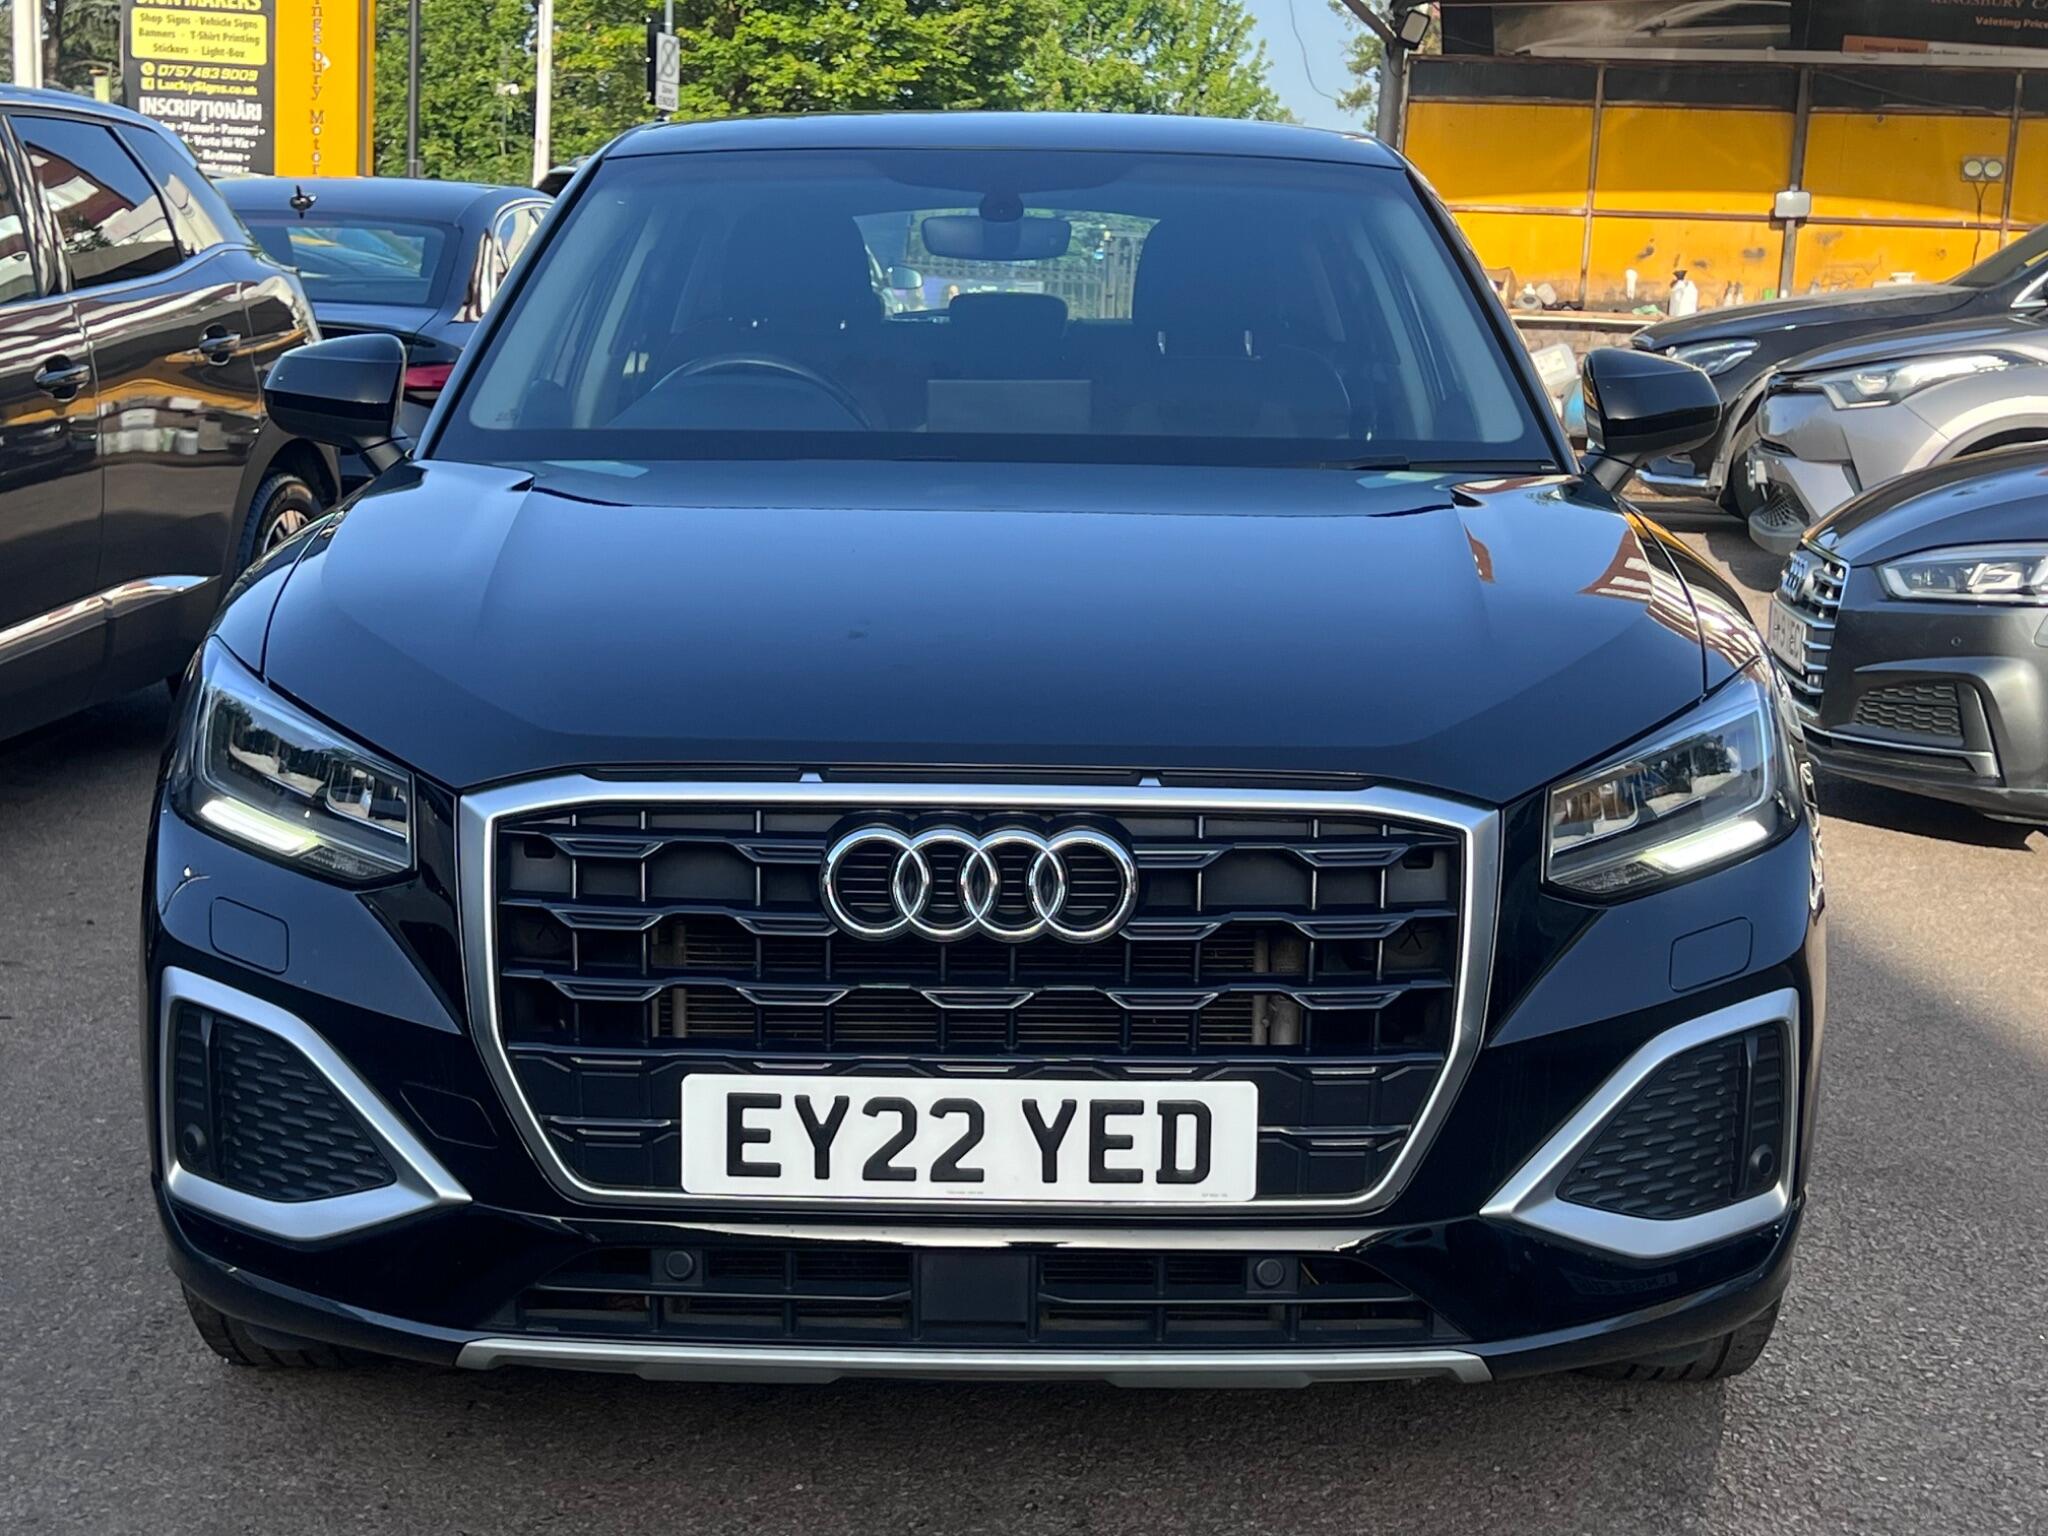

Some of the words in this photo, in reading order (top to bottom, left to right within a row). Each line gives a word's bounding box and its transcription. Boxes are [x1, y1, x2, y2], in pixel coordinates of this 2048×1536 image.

[140, 13, 162, 24] Shop
[166, 14, 191, 26] Signs
[199, 16, 232, 27] Vehicle
[234, 19, 258, 30] Signs
[1975, 15, 2021, 29] Valeting
[139, 27, 175, 38] Banners
[190, 30, 221, 41] T-Shirt
[222, 32, 261, 47] Printing
[153, 42, 189, 54] Stickers
[726, 1092, 985, 1182] EY22
[1021, 1098, 1213, 1185] YED
